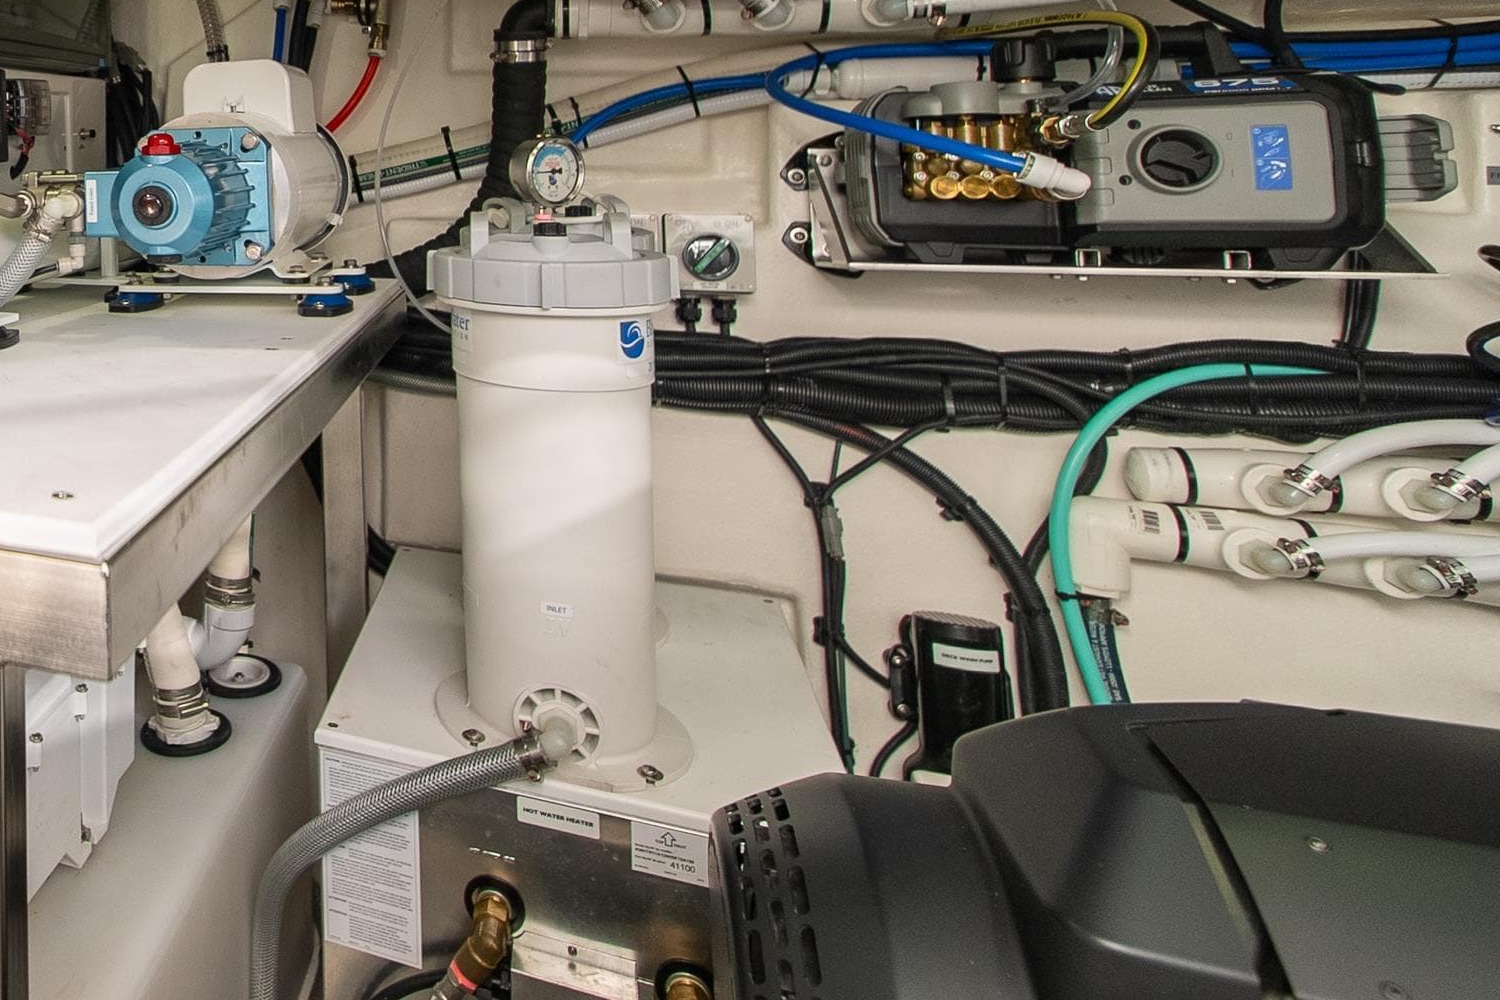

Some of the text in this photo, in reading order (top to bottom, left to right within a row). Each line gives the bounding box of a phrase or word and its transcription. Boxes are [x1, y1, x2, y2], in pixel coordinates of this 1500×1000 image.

[523, 807, 594, 828] HOT WATER HEATER
[669, 861, 697, 874] 41100
